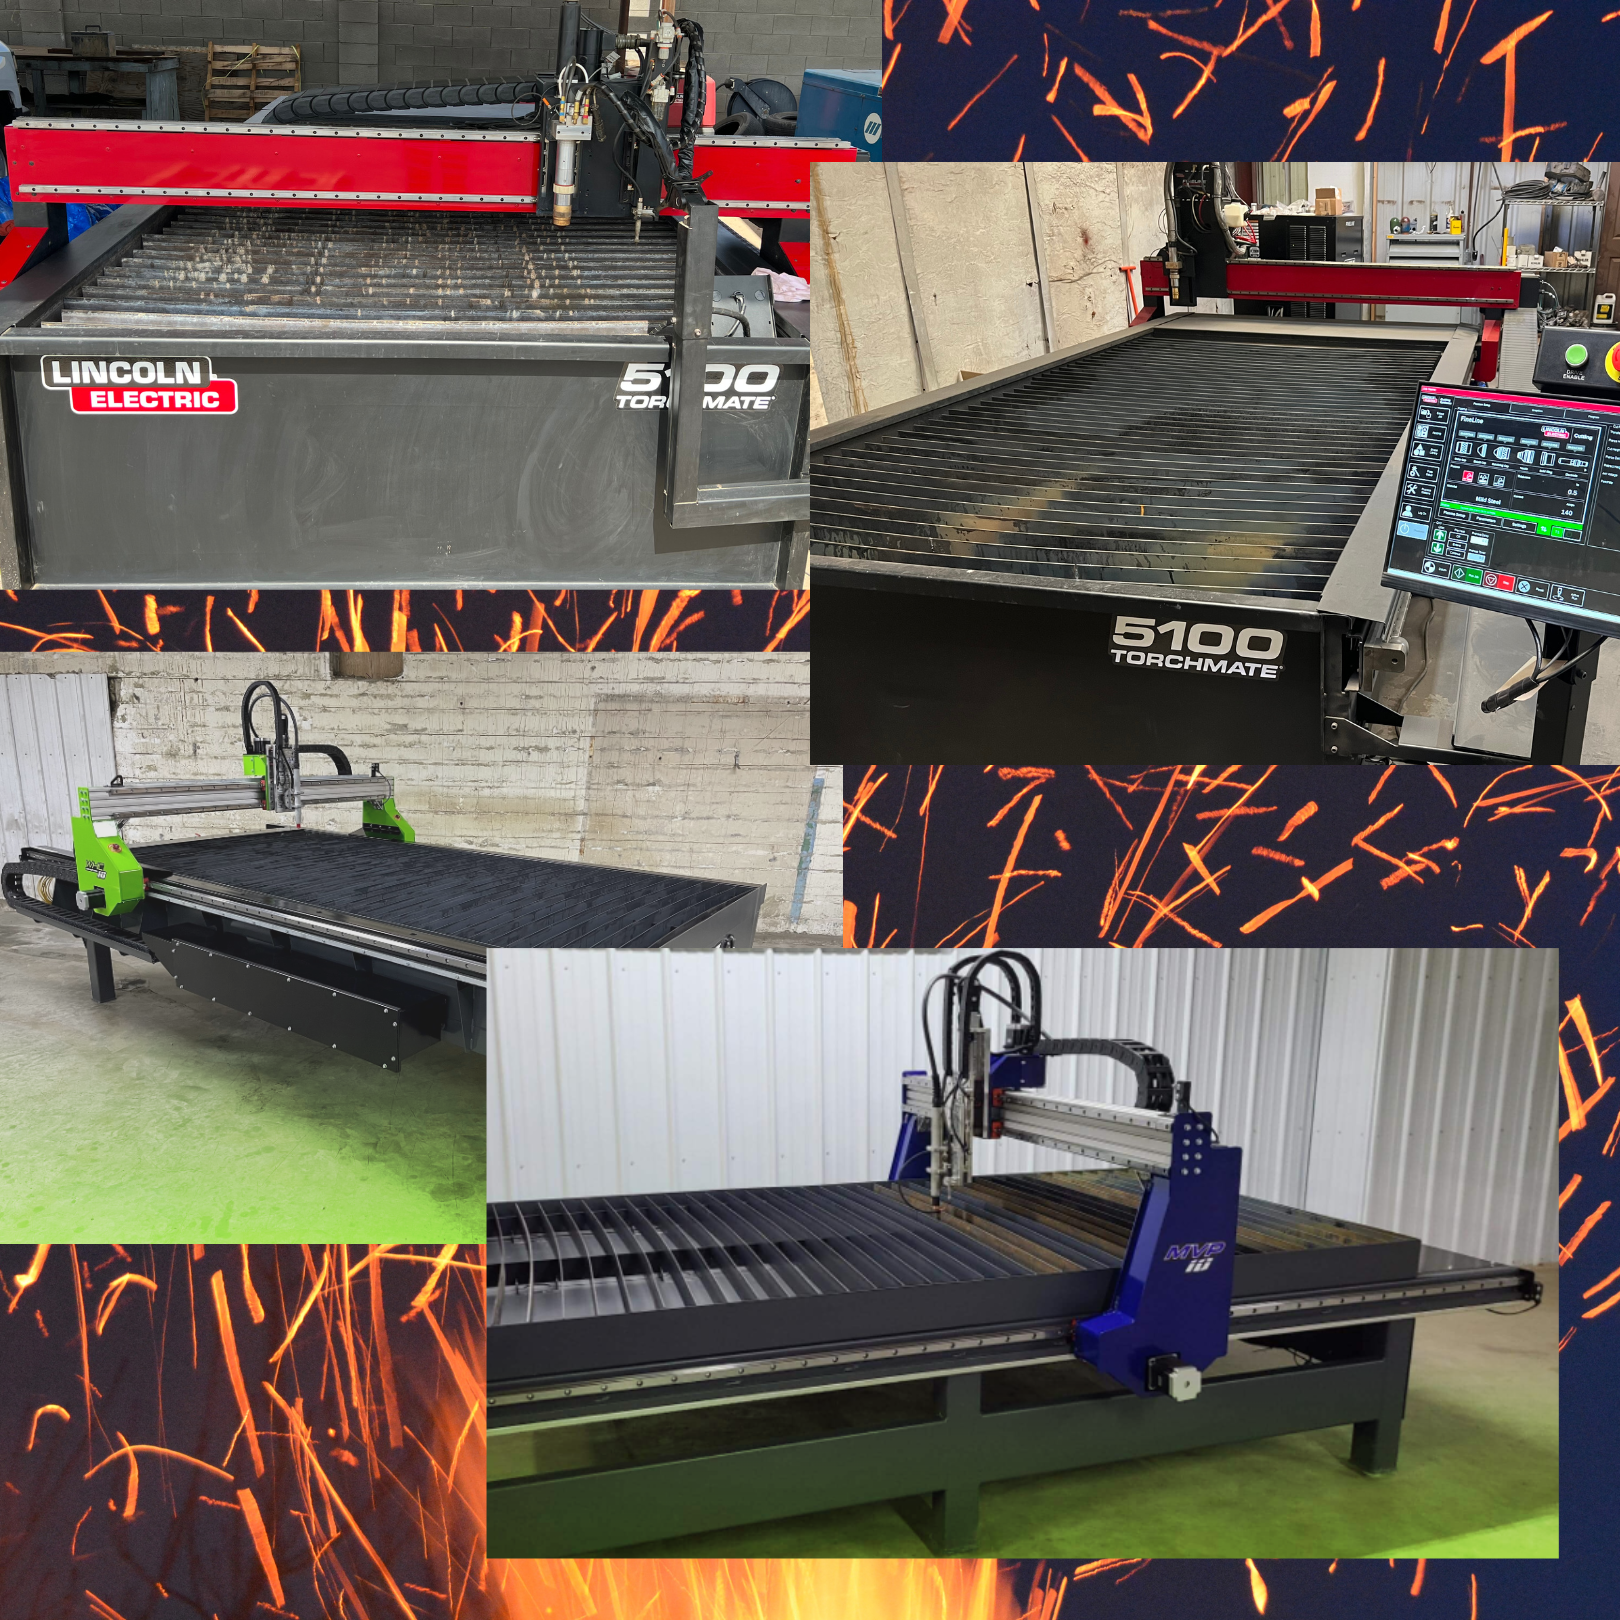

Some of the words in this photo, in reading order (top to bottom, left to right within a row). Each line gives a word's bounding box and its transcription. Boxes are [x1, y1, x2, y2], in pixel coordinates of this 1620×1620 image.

[51, 360, 201, 384] LINCOLN
[620, 363, 780, 393] 500
[90, 390, 220, 408] ELECTRIC
[615, 395, 771, 410] TORMATE
[1460, 415, 1484, 424] FineLine
[1574, 433, 1594, 441] Cutting
[1475, 495, 1487, 503] Mild
[1487, 497, 1502, 505] Steel
[1560, 509, 1574, 517] 140
[1112, 615, 1284, 660] 5100
[1110, 649, 1279, 679] TORCHMATE
[1163, 1241, 1226, 1261] MVP
